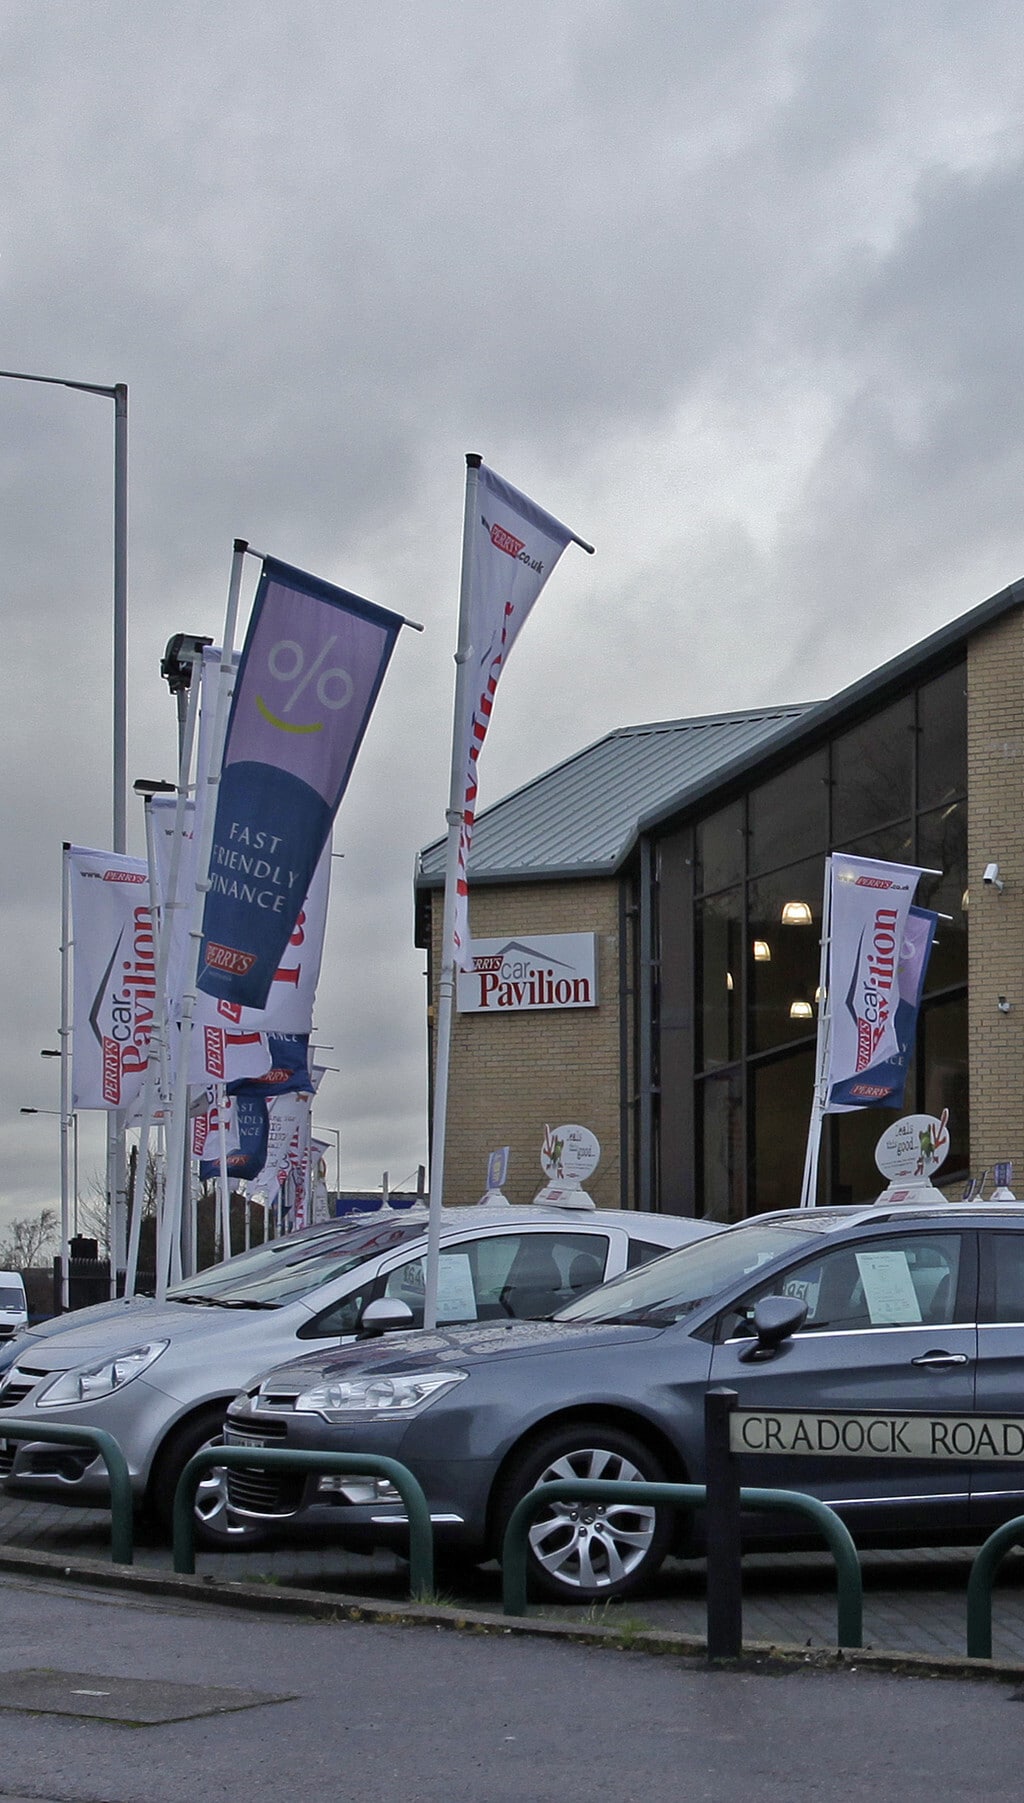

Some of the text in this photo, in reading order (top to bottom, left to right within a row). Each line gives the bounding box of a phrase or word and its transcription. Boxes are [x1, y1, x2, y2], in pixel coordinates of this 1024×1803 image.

[229, 822, 283, 854] FAST
[478, 969, 591, 1007] Pavilion
[501, 962, 531, 980] car
[121, 906, 160, 1078] Pavilion
[863, 981, 877, 1023] car
[103, 994, 131, 1101] PERRYS car
[742, 1418, 912, 1453] CRADOCK
